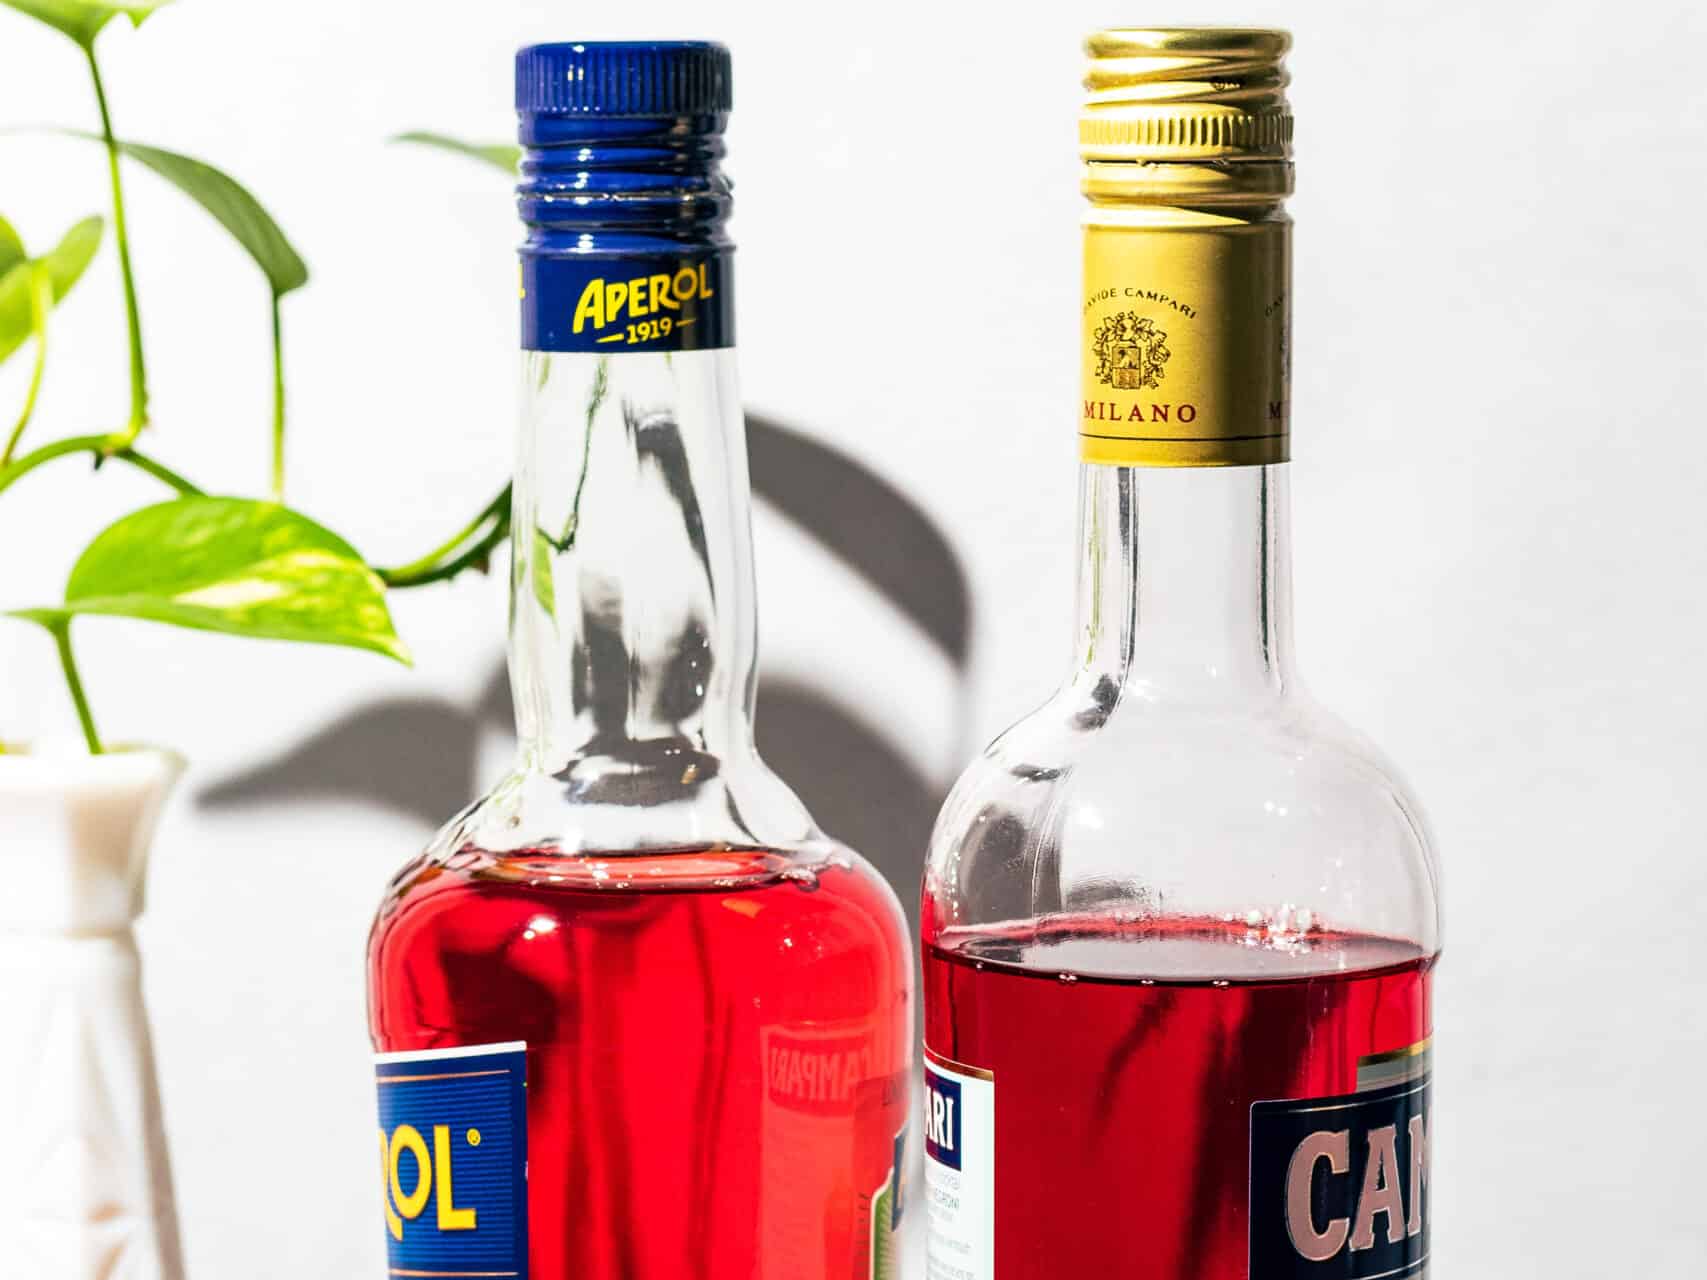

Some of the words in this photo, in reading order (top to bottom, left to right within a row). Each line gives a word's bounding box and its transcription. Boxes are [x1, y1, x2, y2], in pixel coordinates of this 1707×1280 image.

[572, 263, 713, 334] APEROL
[1124, 287, 1197, 320] CAMPARI
[626, 317, 673, 344] 1919
[1083, 400, 1197, 423] MILANO
